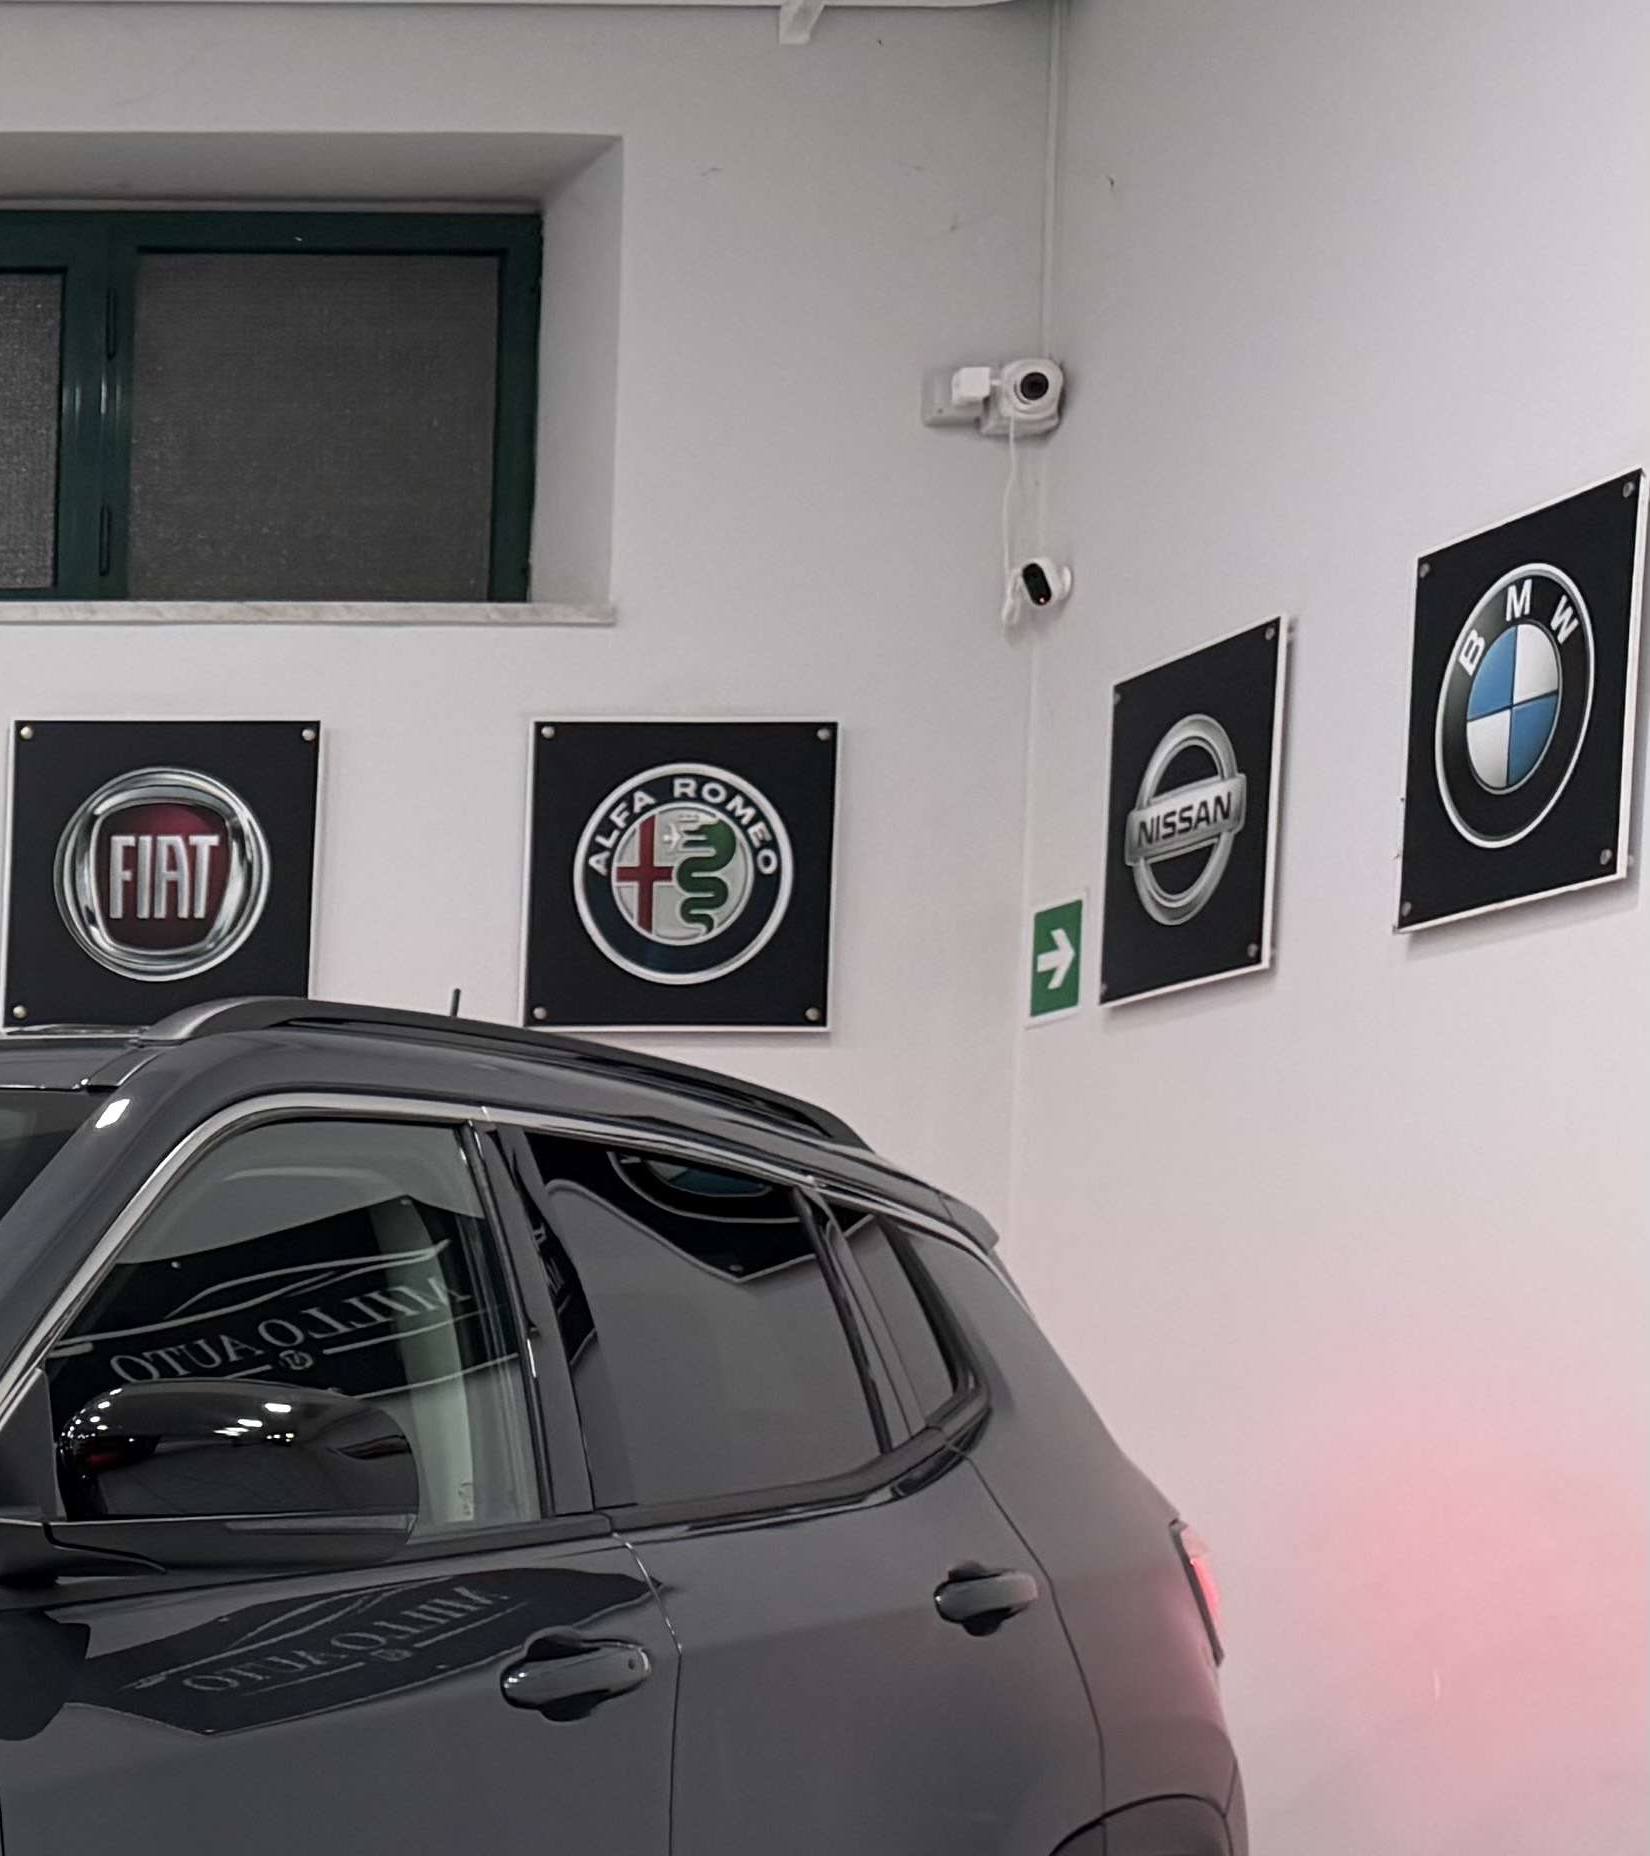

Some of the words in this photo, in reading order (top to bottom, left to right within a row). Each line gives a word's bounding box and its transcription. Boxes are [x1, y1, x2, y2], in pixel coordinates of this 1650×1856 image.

[1457, 580, 1579, 675] BMW
[587, 787, 657, 877] ALFA
[673, 775, 777, 876] ROMEO
[1136, 790, 1233, 849] NISSAN
[109, 833, 220, 920] FIAT
